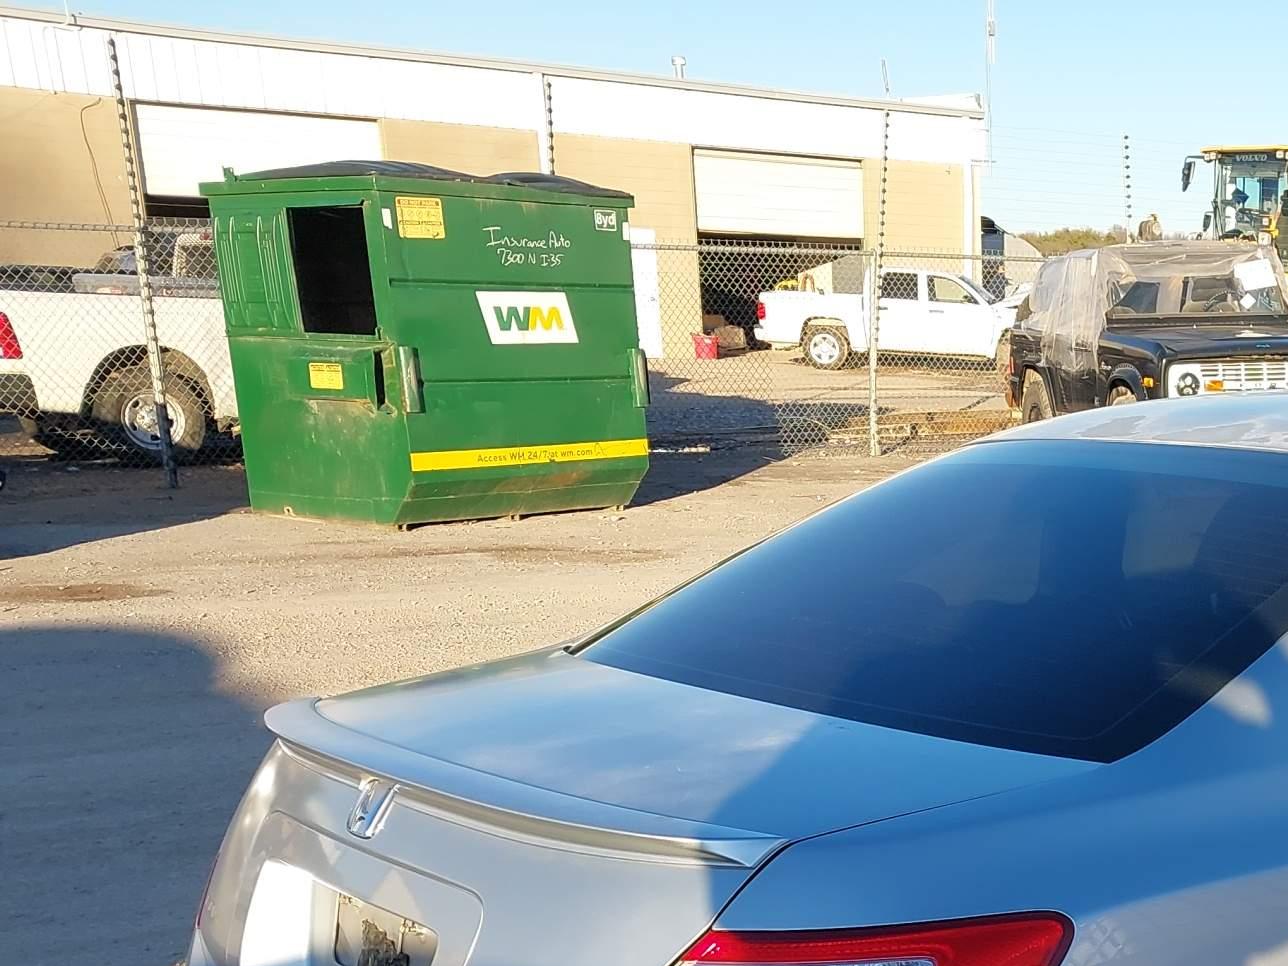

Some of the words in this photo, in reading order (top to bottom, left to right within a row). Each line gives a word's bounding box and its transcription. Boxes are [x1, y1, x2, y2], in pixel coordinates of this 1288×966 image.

[1235, 154, 1268, 162] VOLVO
[482, 226, 547, 248] Insurance
[549, 231, 571, 248] Auto
[497, 248, 525, 266] 7300
[528, 253, 537, 264] N
[540, 253, 565, 267] I-35
[493, 306, 564, 332] WM
[477, 454, 507, 463] Access
[527, 451, 548, 460] 24/7
[561, 449, 593, 457] wm.com
